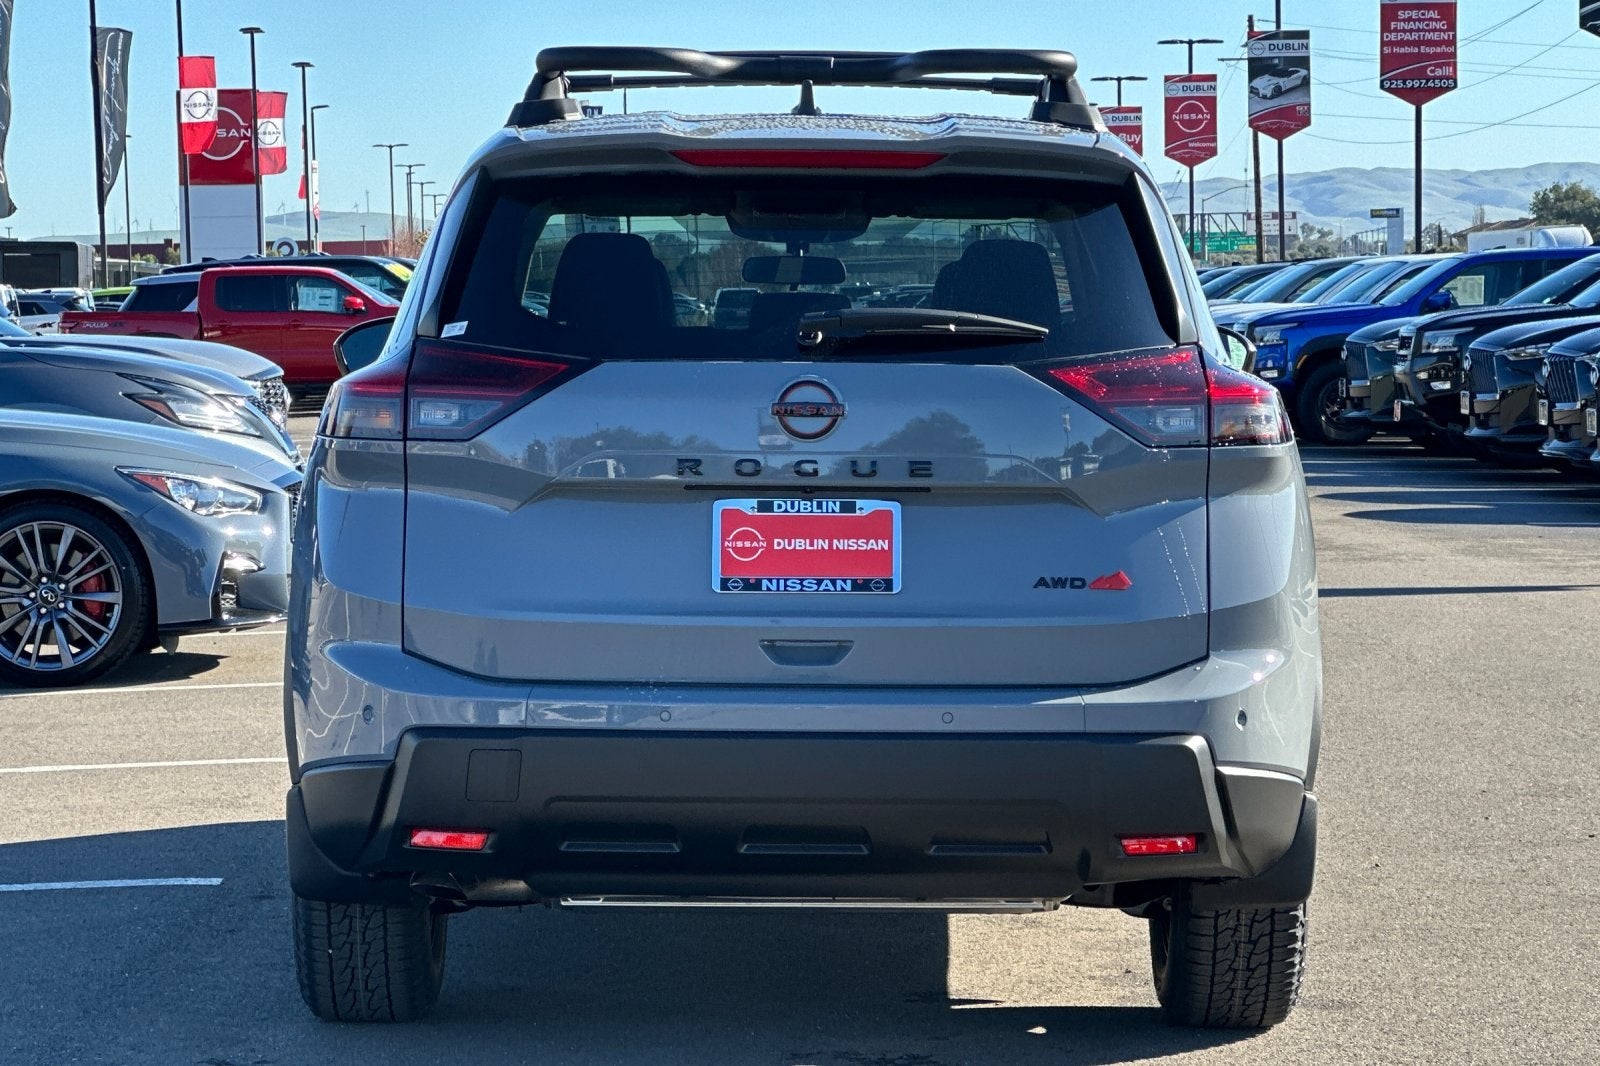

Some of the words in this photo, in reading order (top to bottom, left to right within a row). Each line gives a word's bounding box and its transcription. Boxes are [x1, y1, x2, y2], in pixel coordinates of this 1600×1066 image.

[1397, 10, 1441, 19] SPECIAL
[1390, 21, 1447, 30] FINANCING
[1383, 31, 1455, 41] DEPARTMENT
[1268, 42, 1309, 51] DUBLIN
[1420, 45, 1455, 54] Español
[1426, 66, 1453, 76] Call!
[1181, 84, 1216, 92] DUBLIN
[1383, 79, 1455, 88] 925.997.4505
[216, 128, 252, 138] SAN
[772, 405, 844, 415] NISSAN
[676, 458, 934, 478] ROGUE
[773, 500, 841, 513] DUBLIN
[773, 539, 829, 550] DUBLIN
[832, 539, 889, 550] NISSAN
[761, 578, 852, 591] NISSAN
[1033, 576, 1087, 590] AWD
